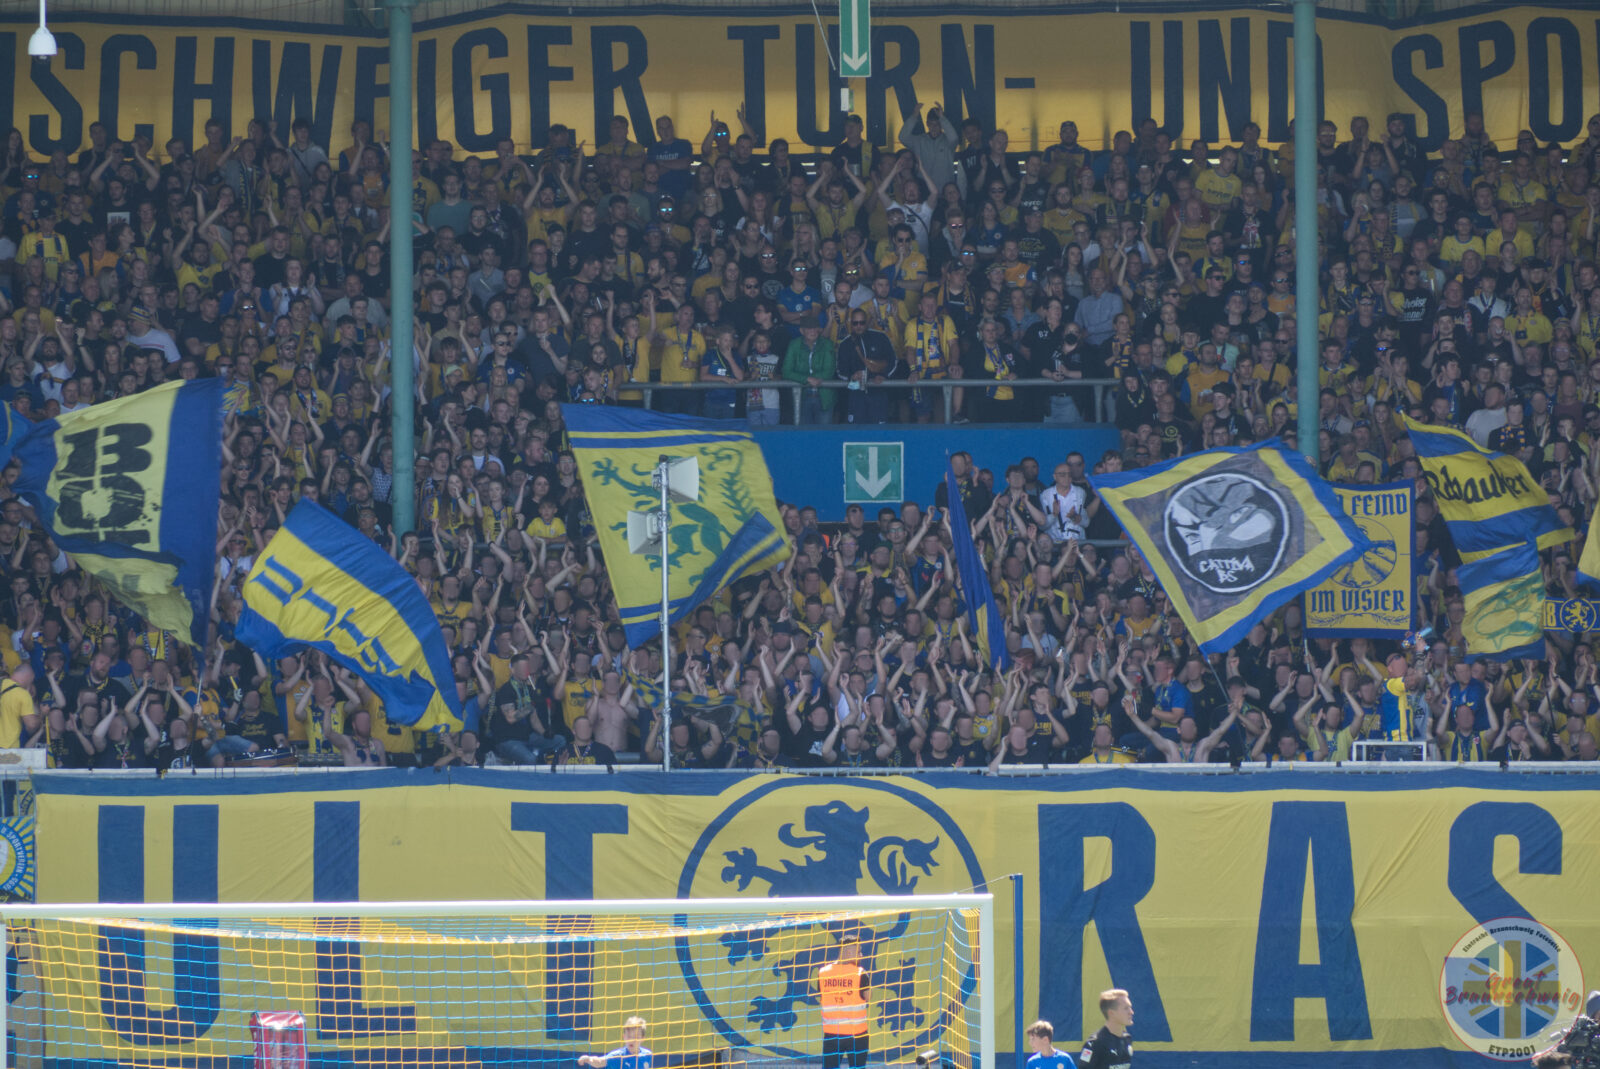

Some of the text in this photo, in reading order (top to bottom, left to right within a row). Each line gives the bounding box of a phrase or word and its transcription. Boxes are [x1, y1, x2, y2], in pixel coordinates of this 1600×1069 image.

[0, 17, 1600, 160] SCHWEIGER TURN- UND SPO
[1351, 493, 1408, 516] FEIND
[1311, 588, 1406, 613] IM VISIER
